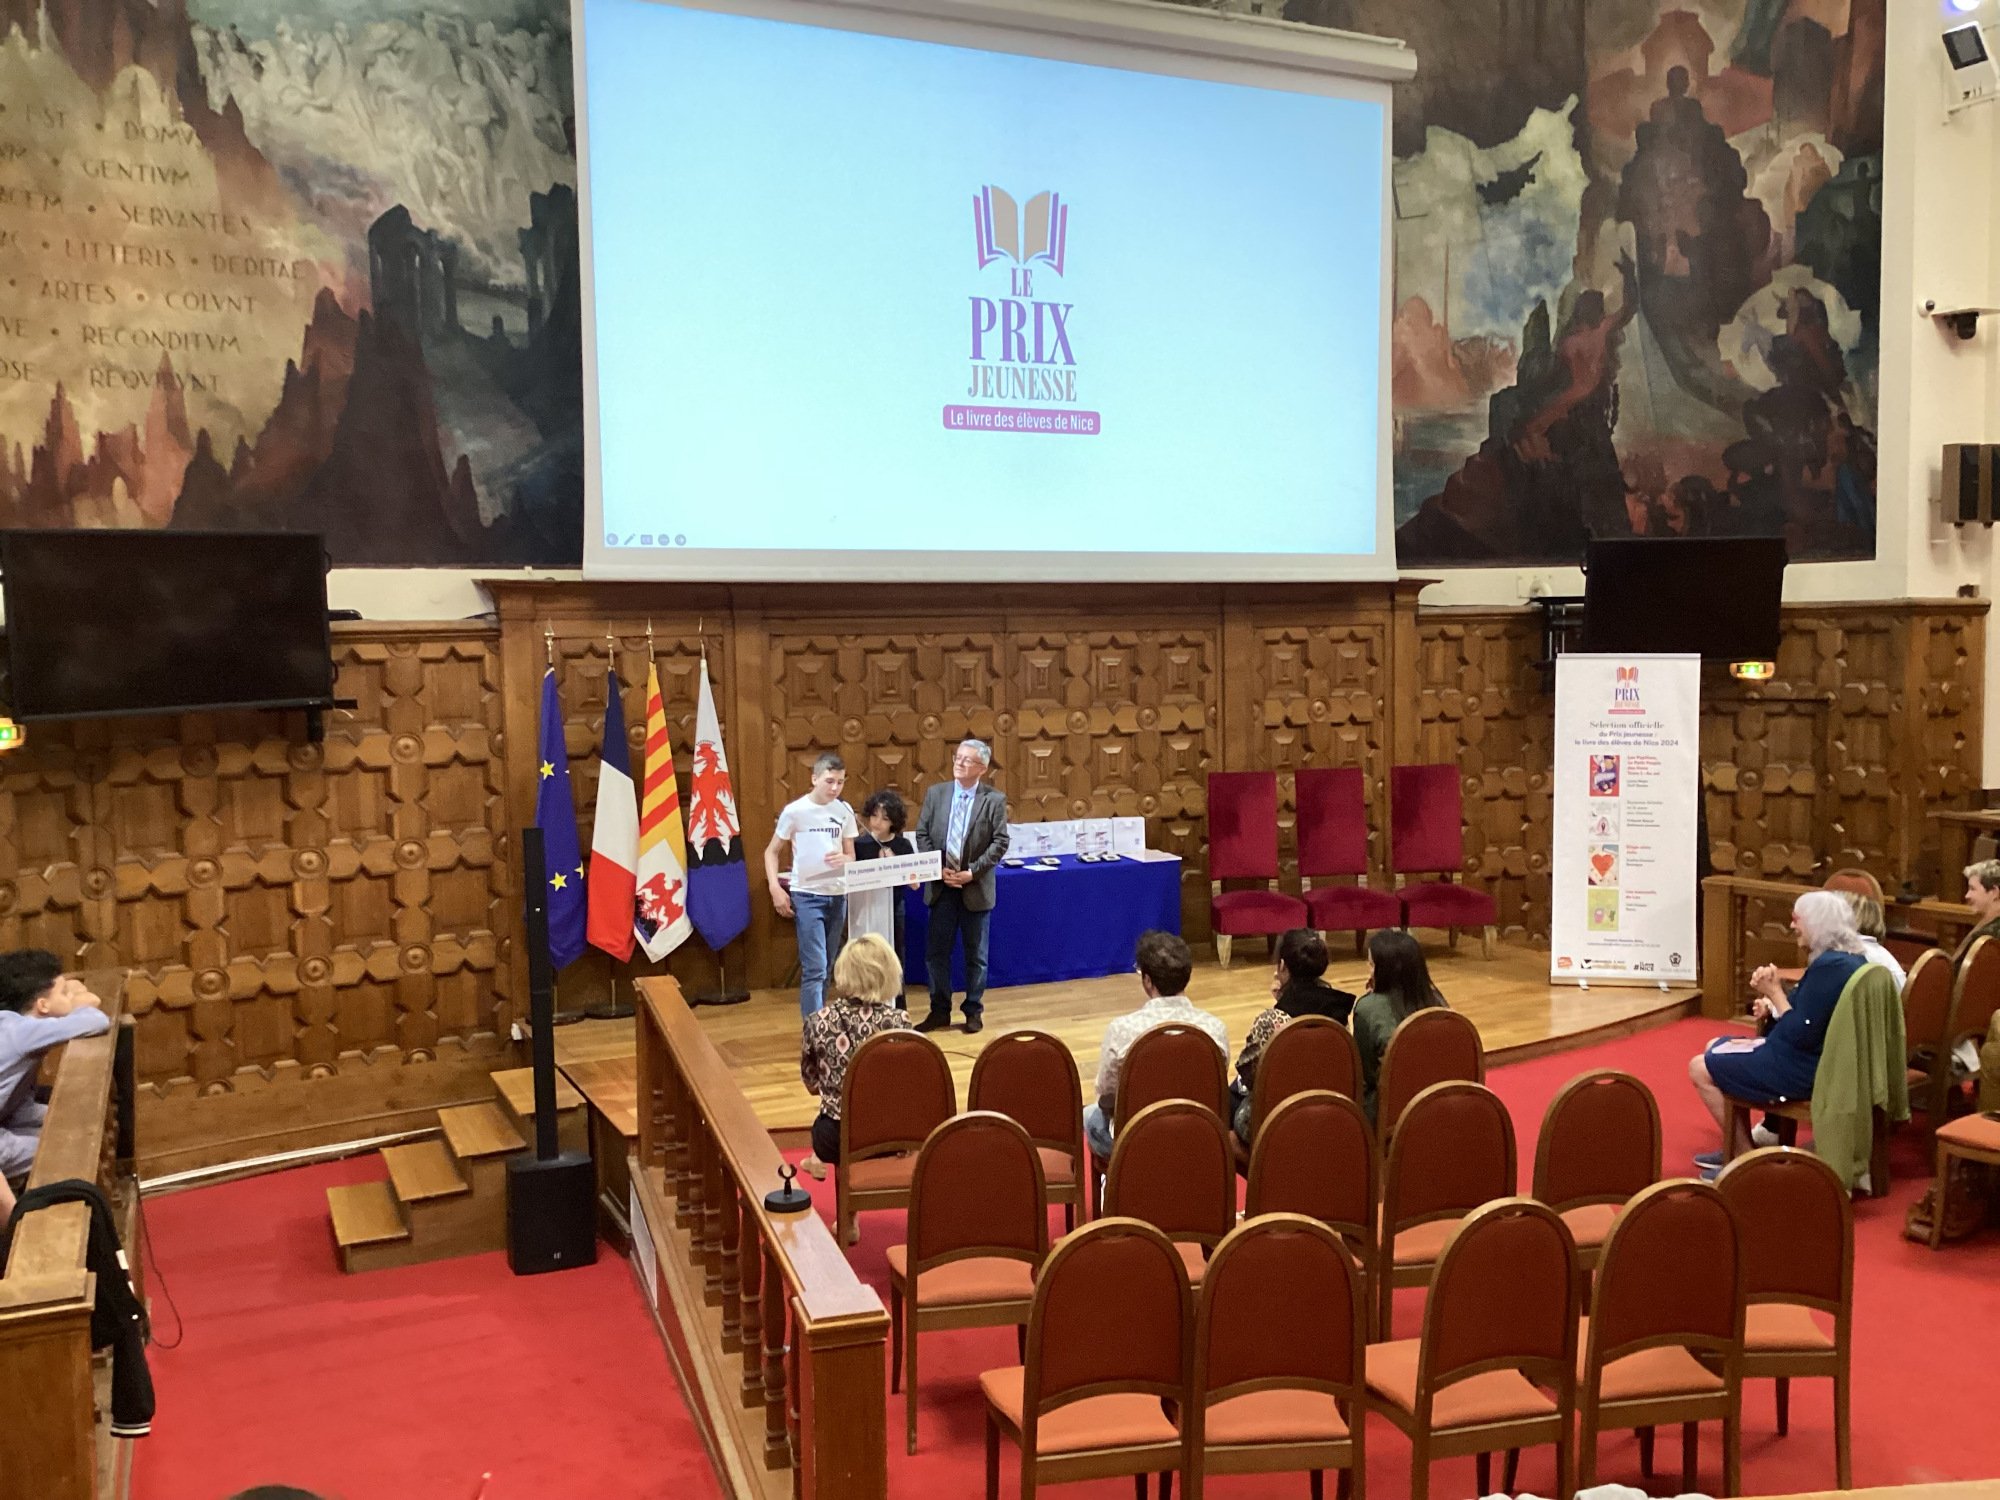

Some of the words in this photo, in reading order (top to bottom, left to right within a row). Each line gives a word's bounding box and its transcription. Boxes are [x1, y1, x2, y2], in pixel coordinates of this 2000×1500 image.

[41, 279, 118, 304] ARTES
[1010, 267, 1033, 298] LE
[968, 296, 1077, 366] PRIX
[967, 364, 1077, 402] JEUNESSE
[950, 408, 964, 426] Le
[966, 409, 992, 427] livre
[994, 410, 1015, 428] des
[1016, 411, 1053, 430] élèves
[1054, 413, 1068, 430] de
[1070, 414, 1095, 431] Nice
[1615, 688, 1640, 701] PRIX
